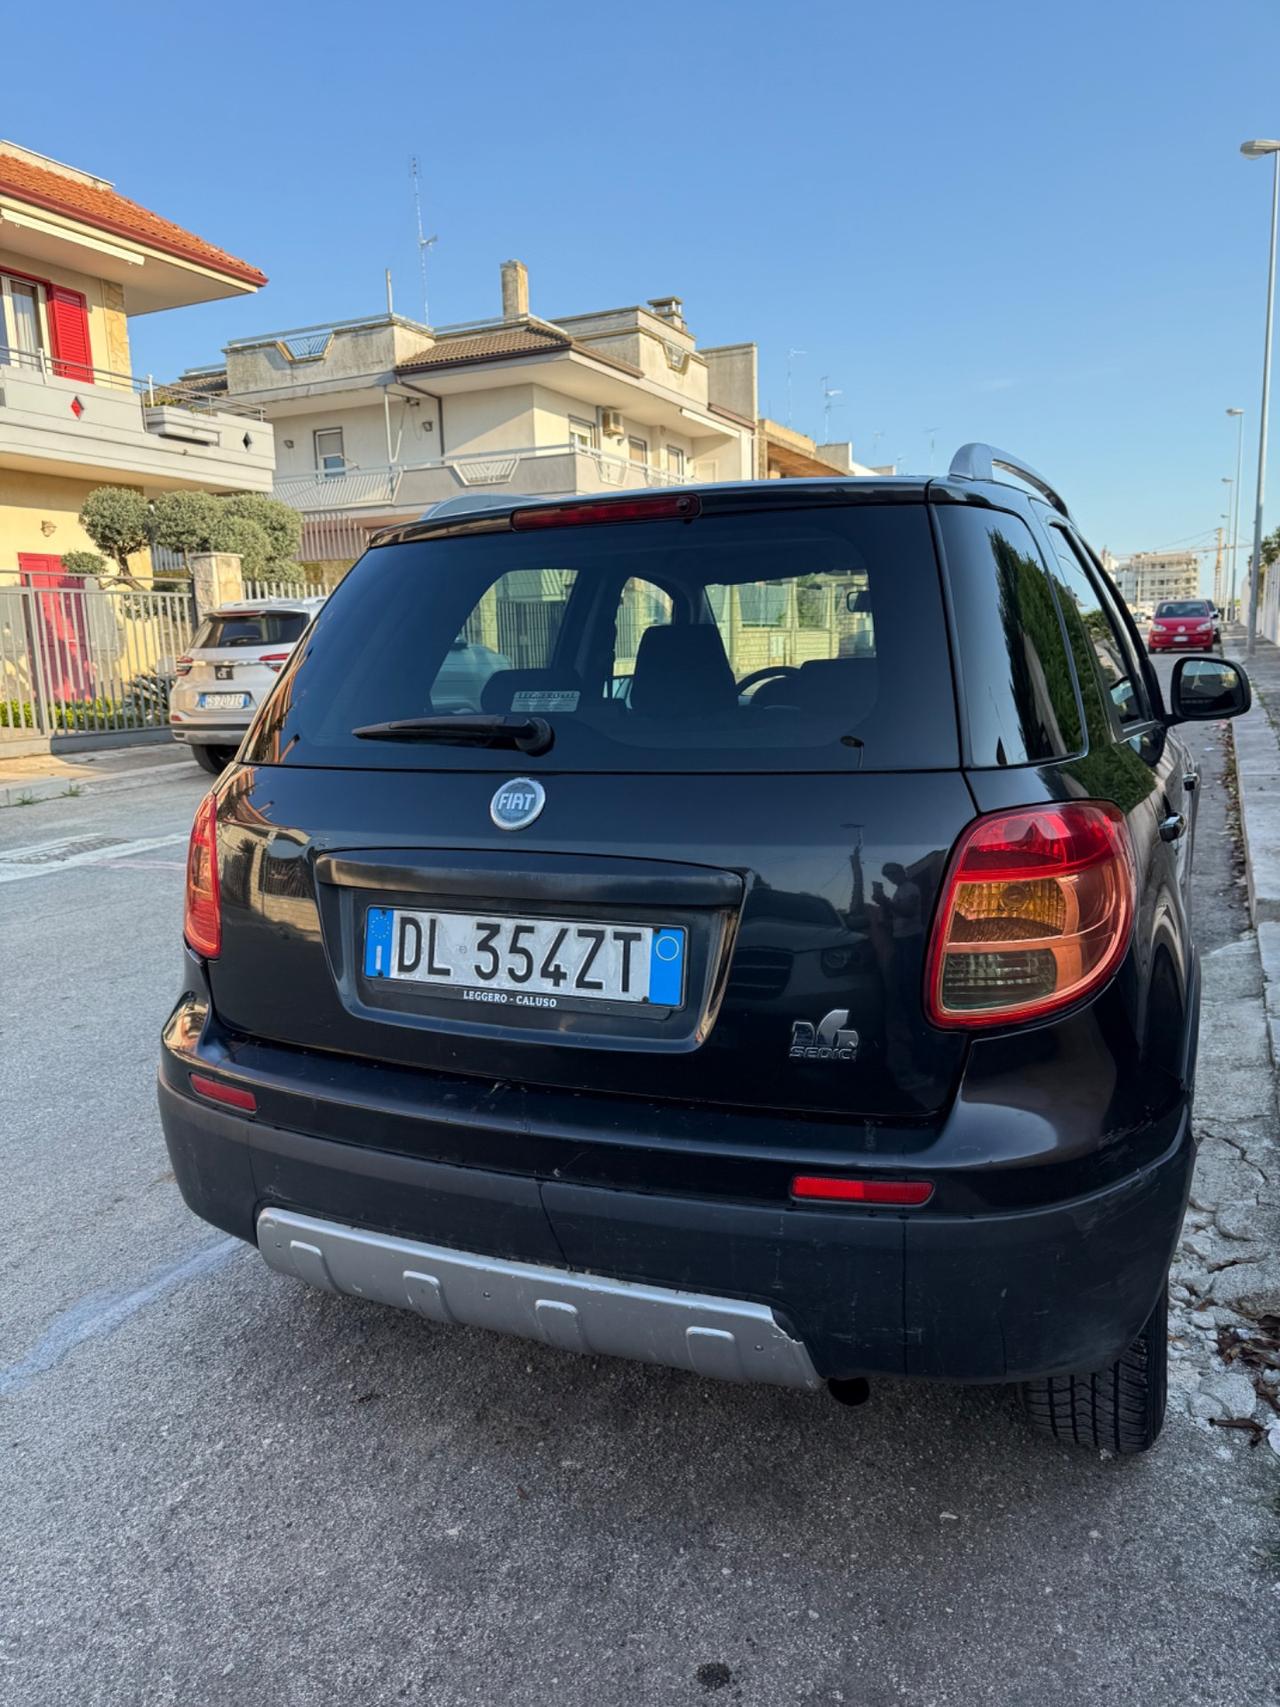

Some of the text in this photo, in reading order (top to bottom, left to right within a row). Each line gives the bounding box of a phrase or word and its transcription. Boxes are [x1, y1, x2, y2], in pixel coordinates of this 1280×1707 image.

[498, 792, 535, 810] FIAT
[397, 916, 451, 976] DL
[474, 921, 642, 993] 354ZT
[463, 990, 508, 1003] LEGGERO
[516, 995, 557, 1008] CALUSO
